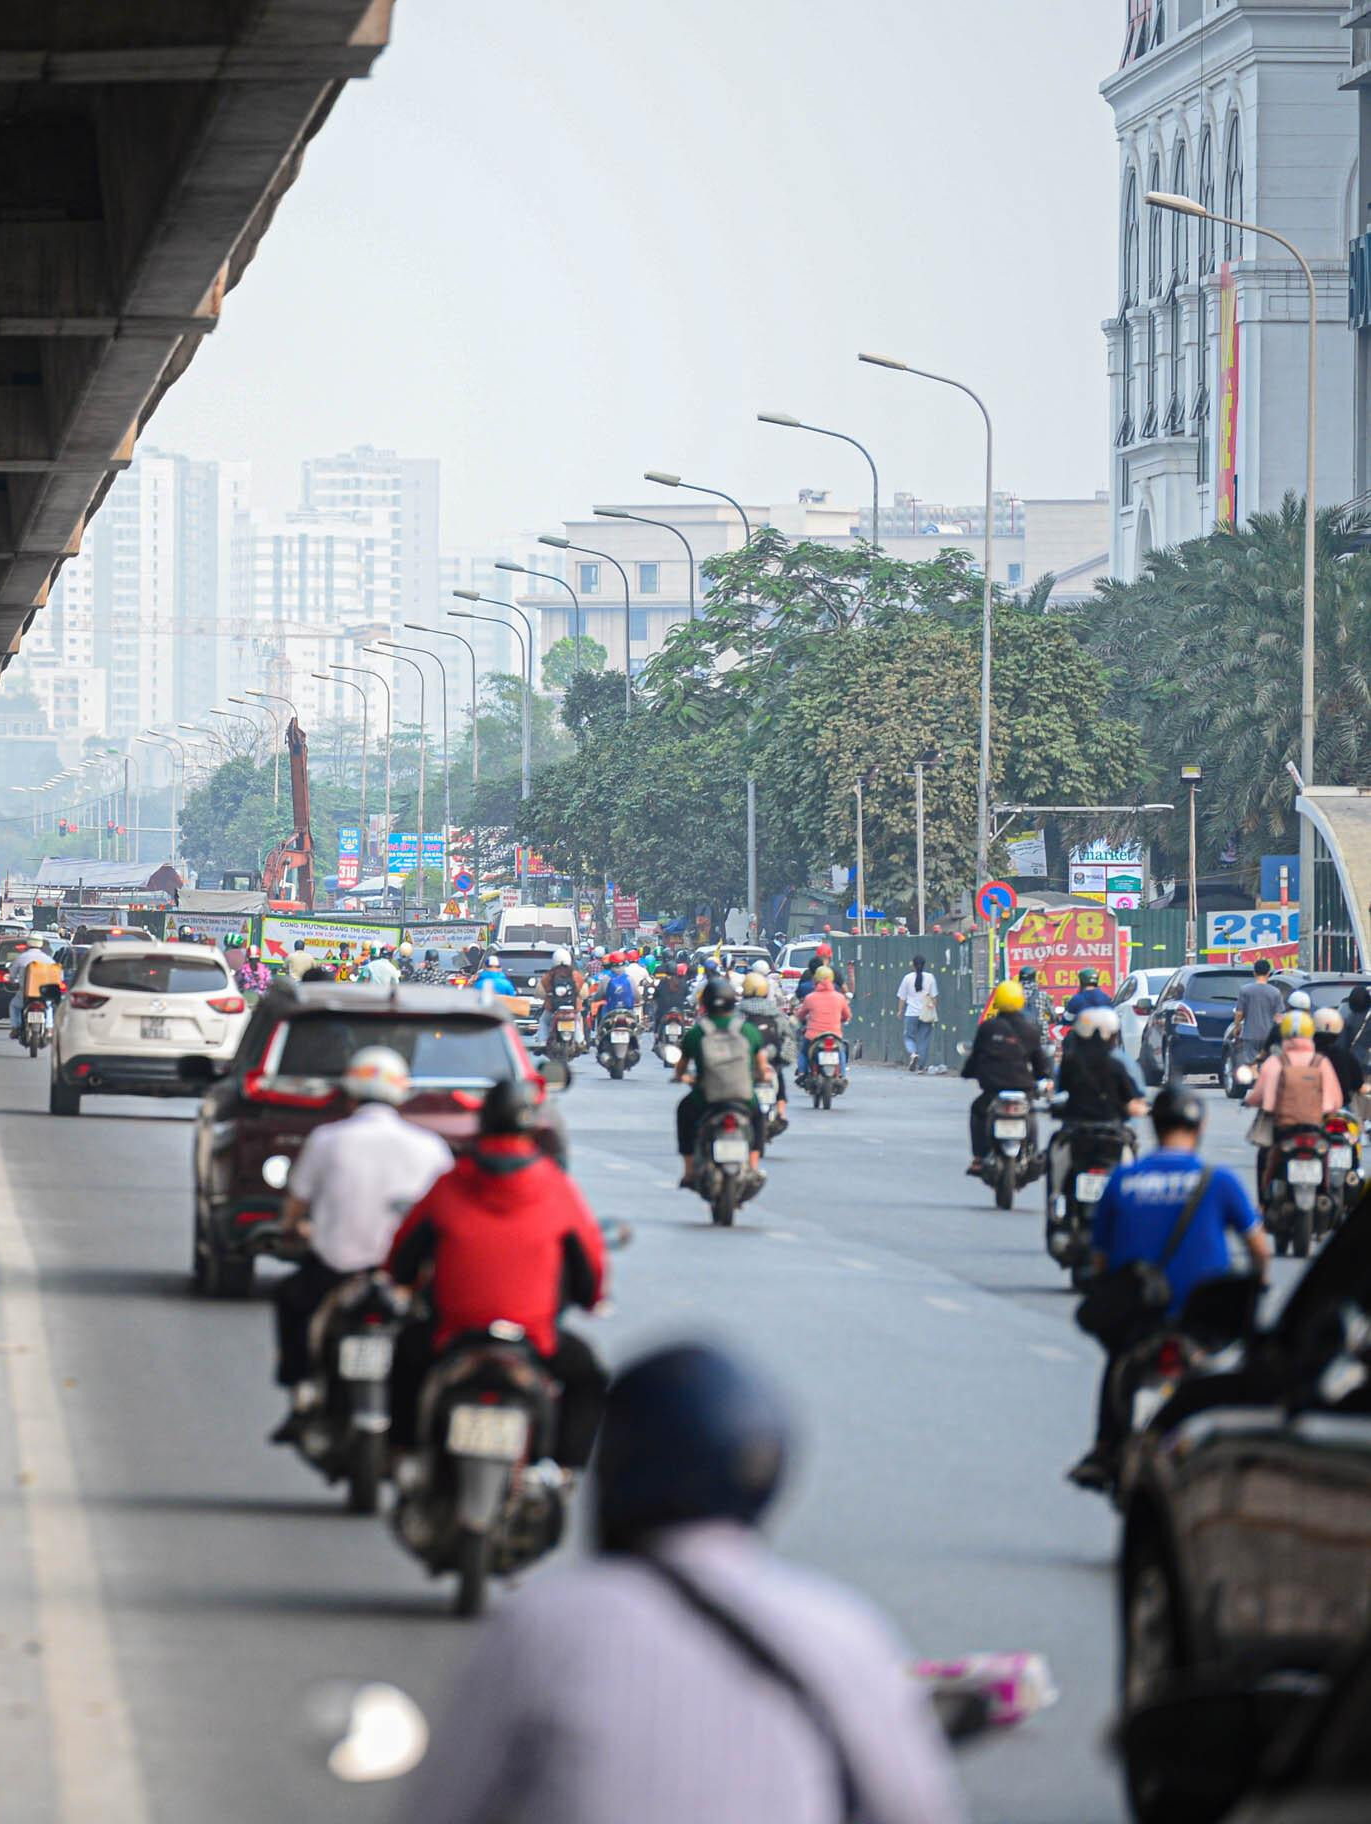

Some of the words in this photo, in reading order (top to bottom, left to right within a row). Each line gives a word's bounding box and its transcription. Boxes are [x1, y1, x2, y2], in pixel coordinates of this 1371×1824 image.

[1018, 911, 1105, 944] 278
[1010, 943, 1068, 962] TRỌNG
[1073, 943, 1113, 956] ANH
